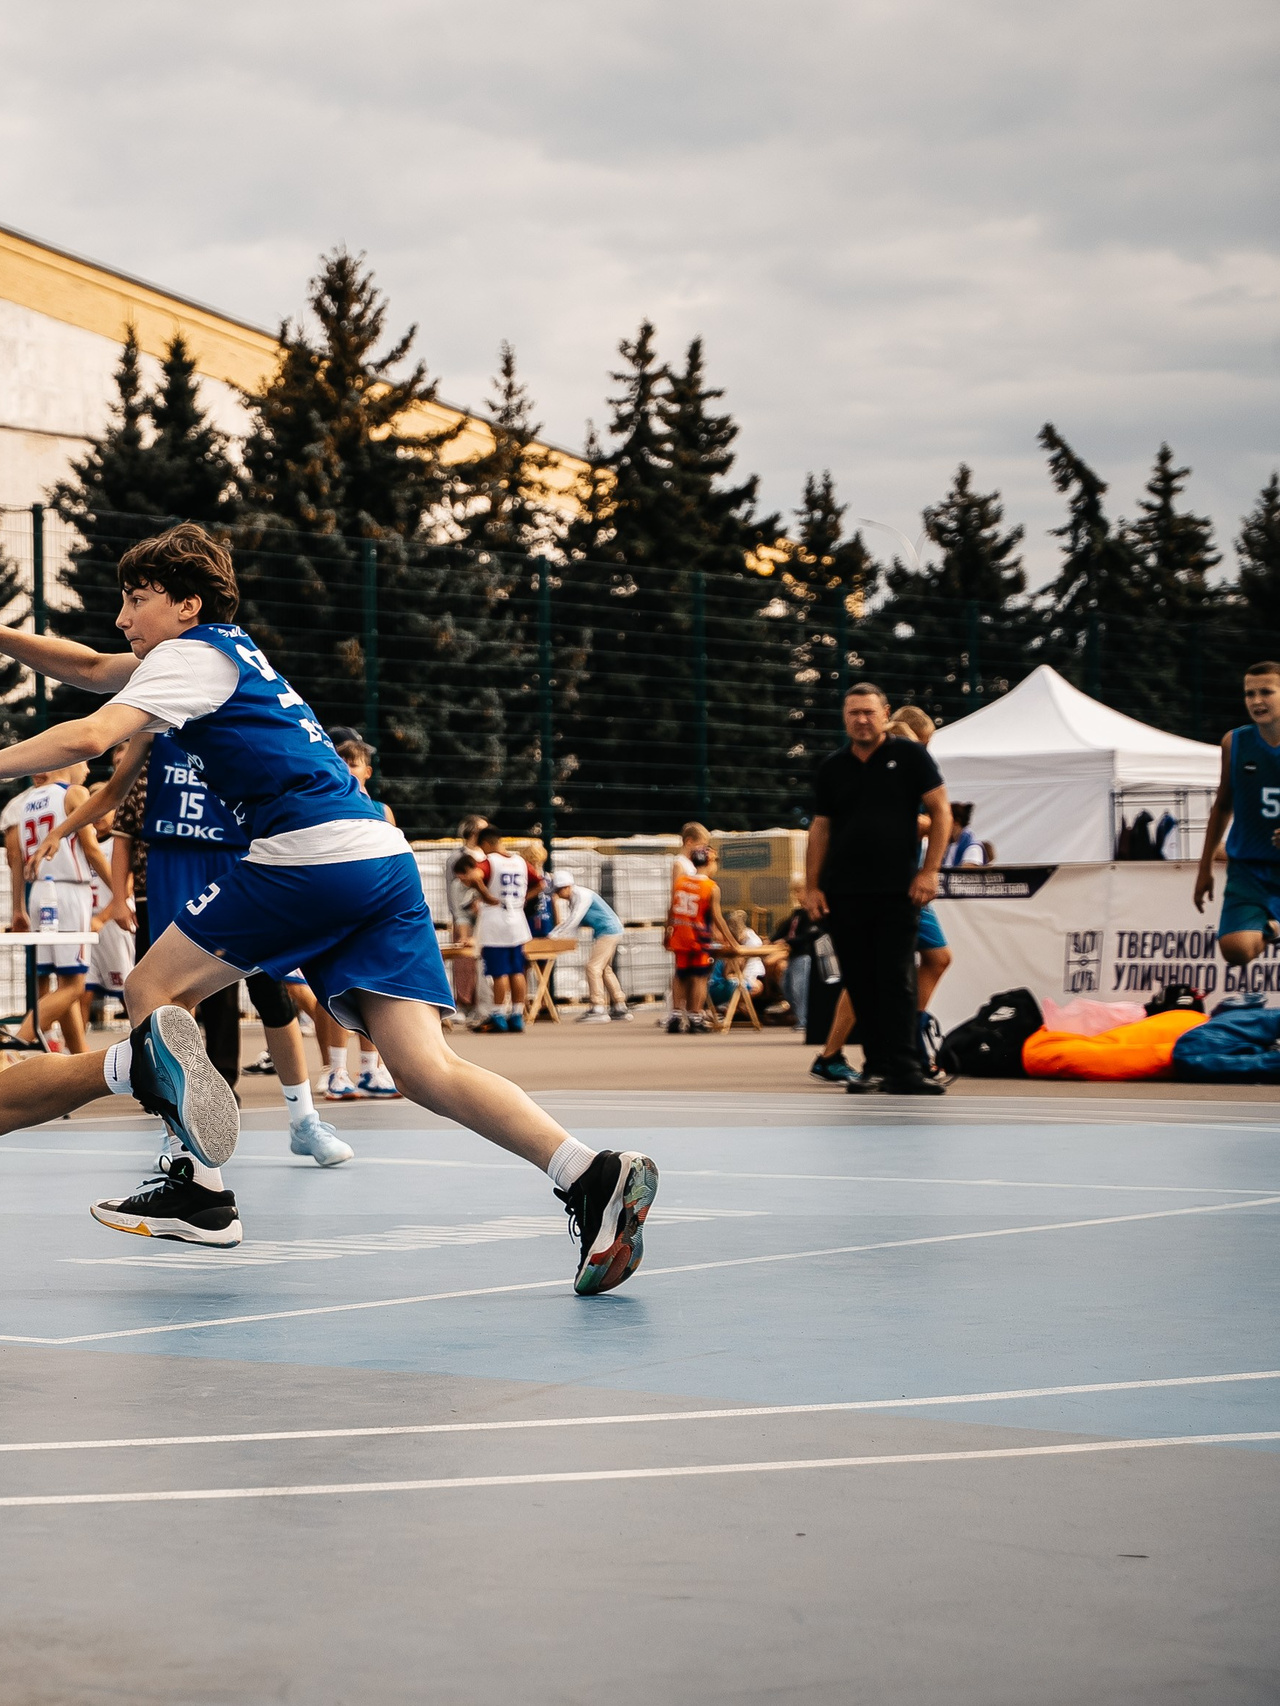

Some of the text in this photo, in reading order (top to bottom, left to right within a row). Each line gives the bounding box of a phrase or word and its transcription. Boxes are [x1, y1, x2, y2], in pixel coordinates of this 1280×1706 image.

[163, 764, 209, 790] ТВЕ
[179, 791, 206, 820] 15
[176, 822, 225, 841] DKC
[1116, 924, 1218, 959] ТВЕРСКОЙ
[1112, 962, 1280, 993] УЛИЧНОГО БАСК
